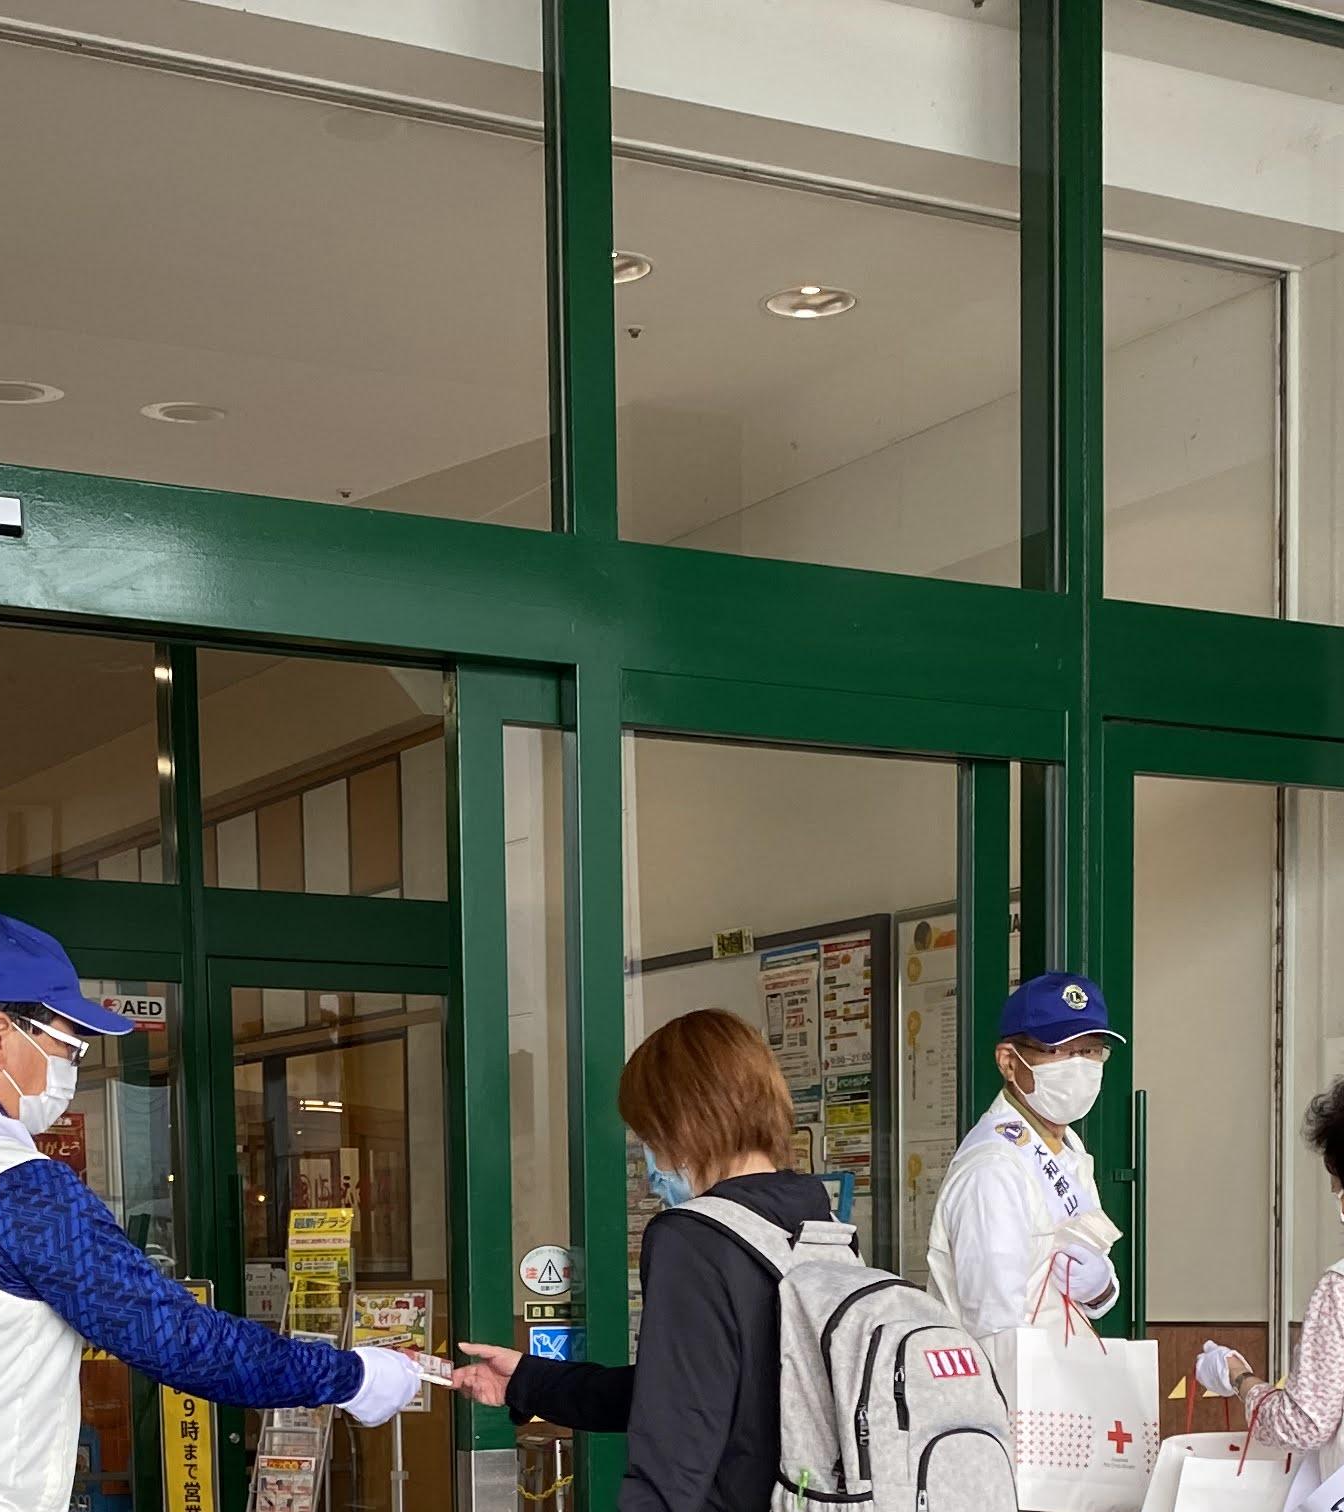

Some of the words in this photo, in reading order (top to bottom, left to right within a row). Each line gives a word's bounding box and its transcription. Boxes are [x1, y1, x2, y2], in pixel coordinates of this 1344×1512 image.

[122, 1001, 162, 1016] AED
[1034, 1144, 1080, 1217] 大和郡山
[926, 1348, 978, 1377] ROXY
